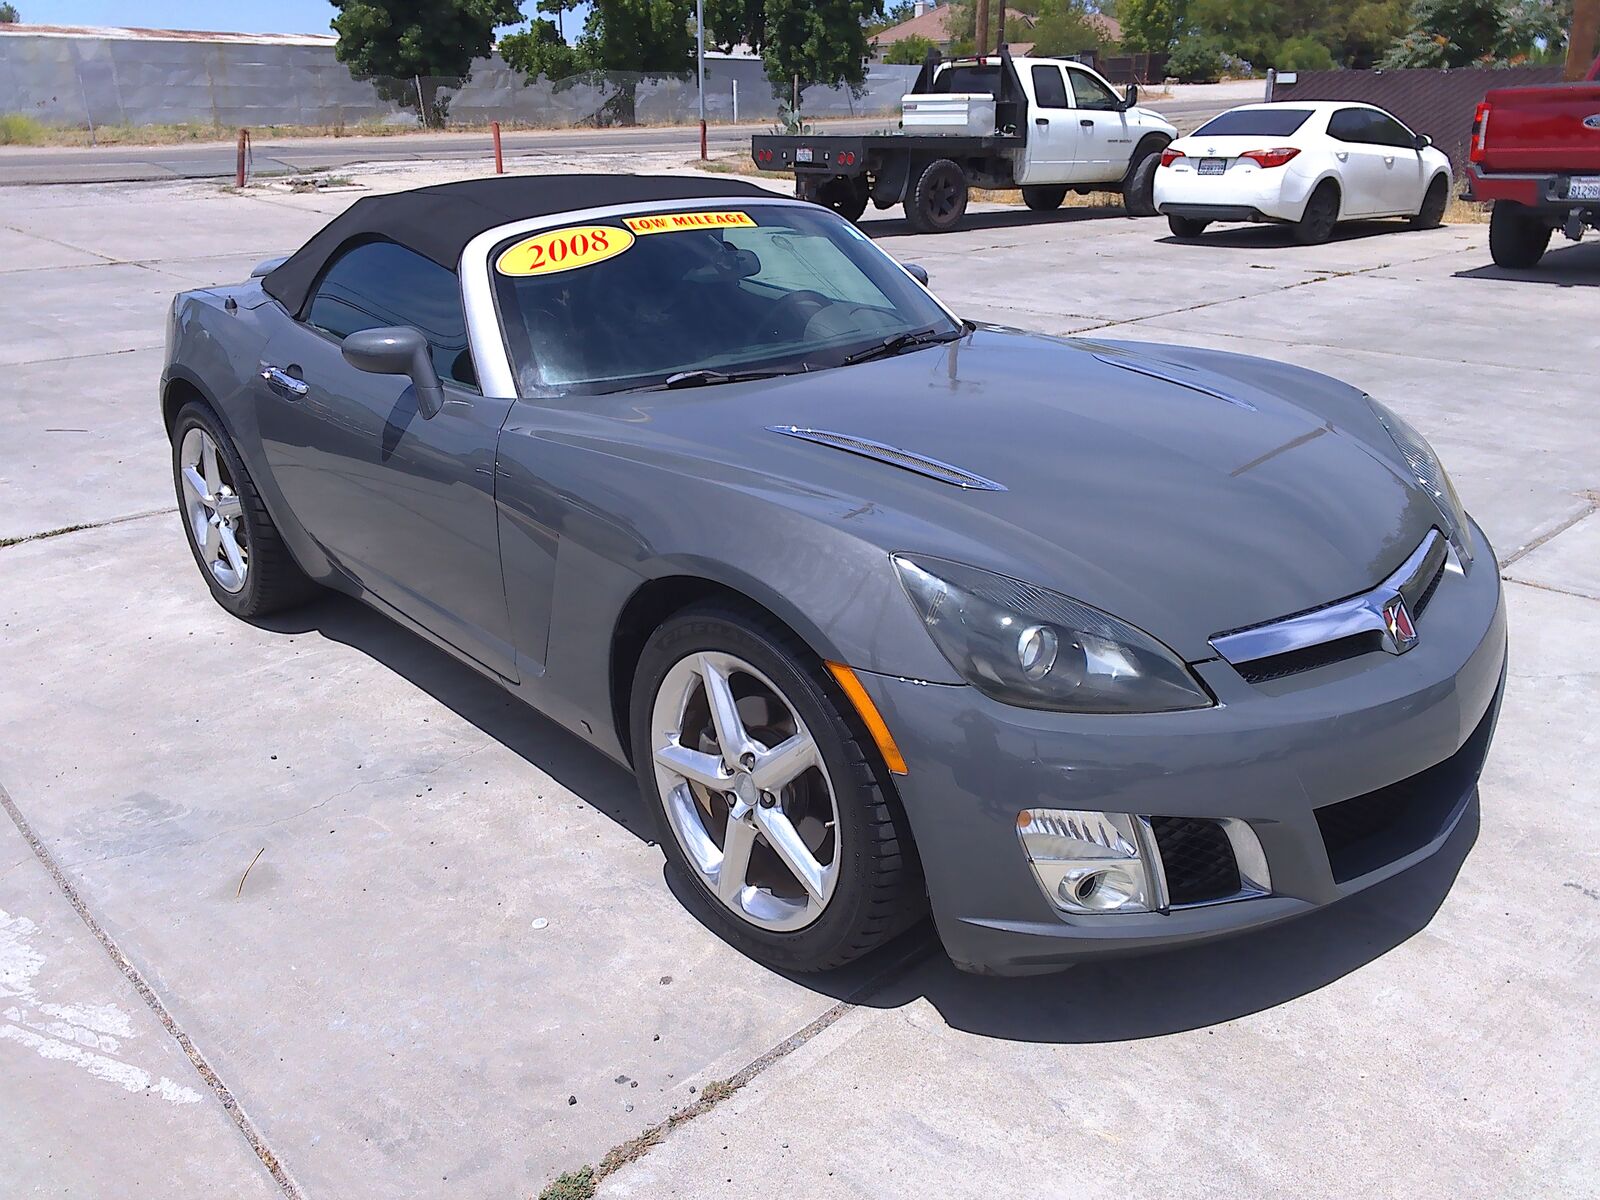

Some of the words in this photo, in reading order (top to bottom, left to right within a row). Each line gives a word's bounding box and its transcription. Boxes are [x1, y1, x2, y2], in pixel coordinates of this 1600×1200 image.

[1571, 185, 1600, 196] 81298
[629, 218, 667, 231] LOW
[674, 213, 749, 226] MILEAGE
[527, 229, 610, 270] 2008
